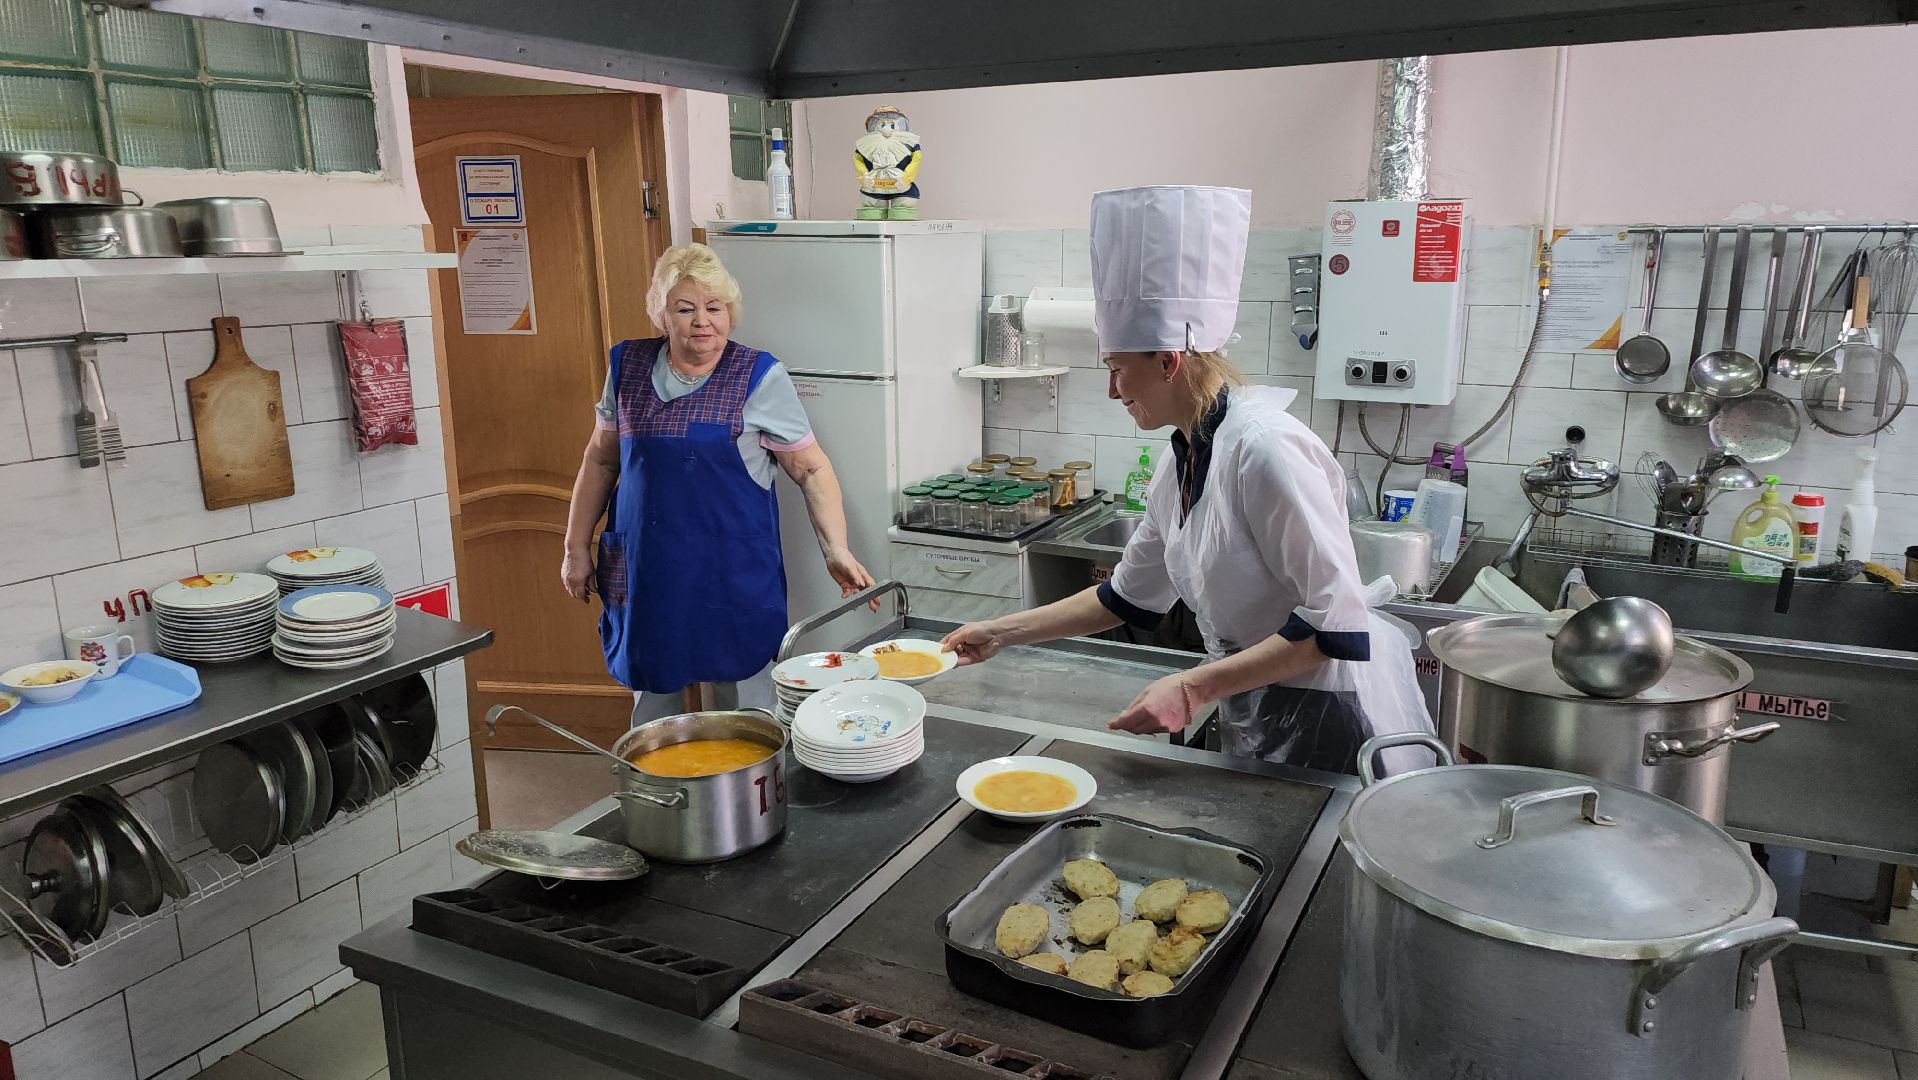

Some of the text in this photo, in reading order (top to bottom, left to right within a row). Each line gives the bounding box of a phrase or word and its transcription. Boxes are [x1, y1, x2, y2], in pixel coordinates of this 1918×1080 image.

[485, 204, 499, 215] 01
[1092, 564, 1107, 580] Для
[1415, 657, 1438, 675] ние
